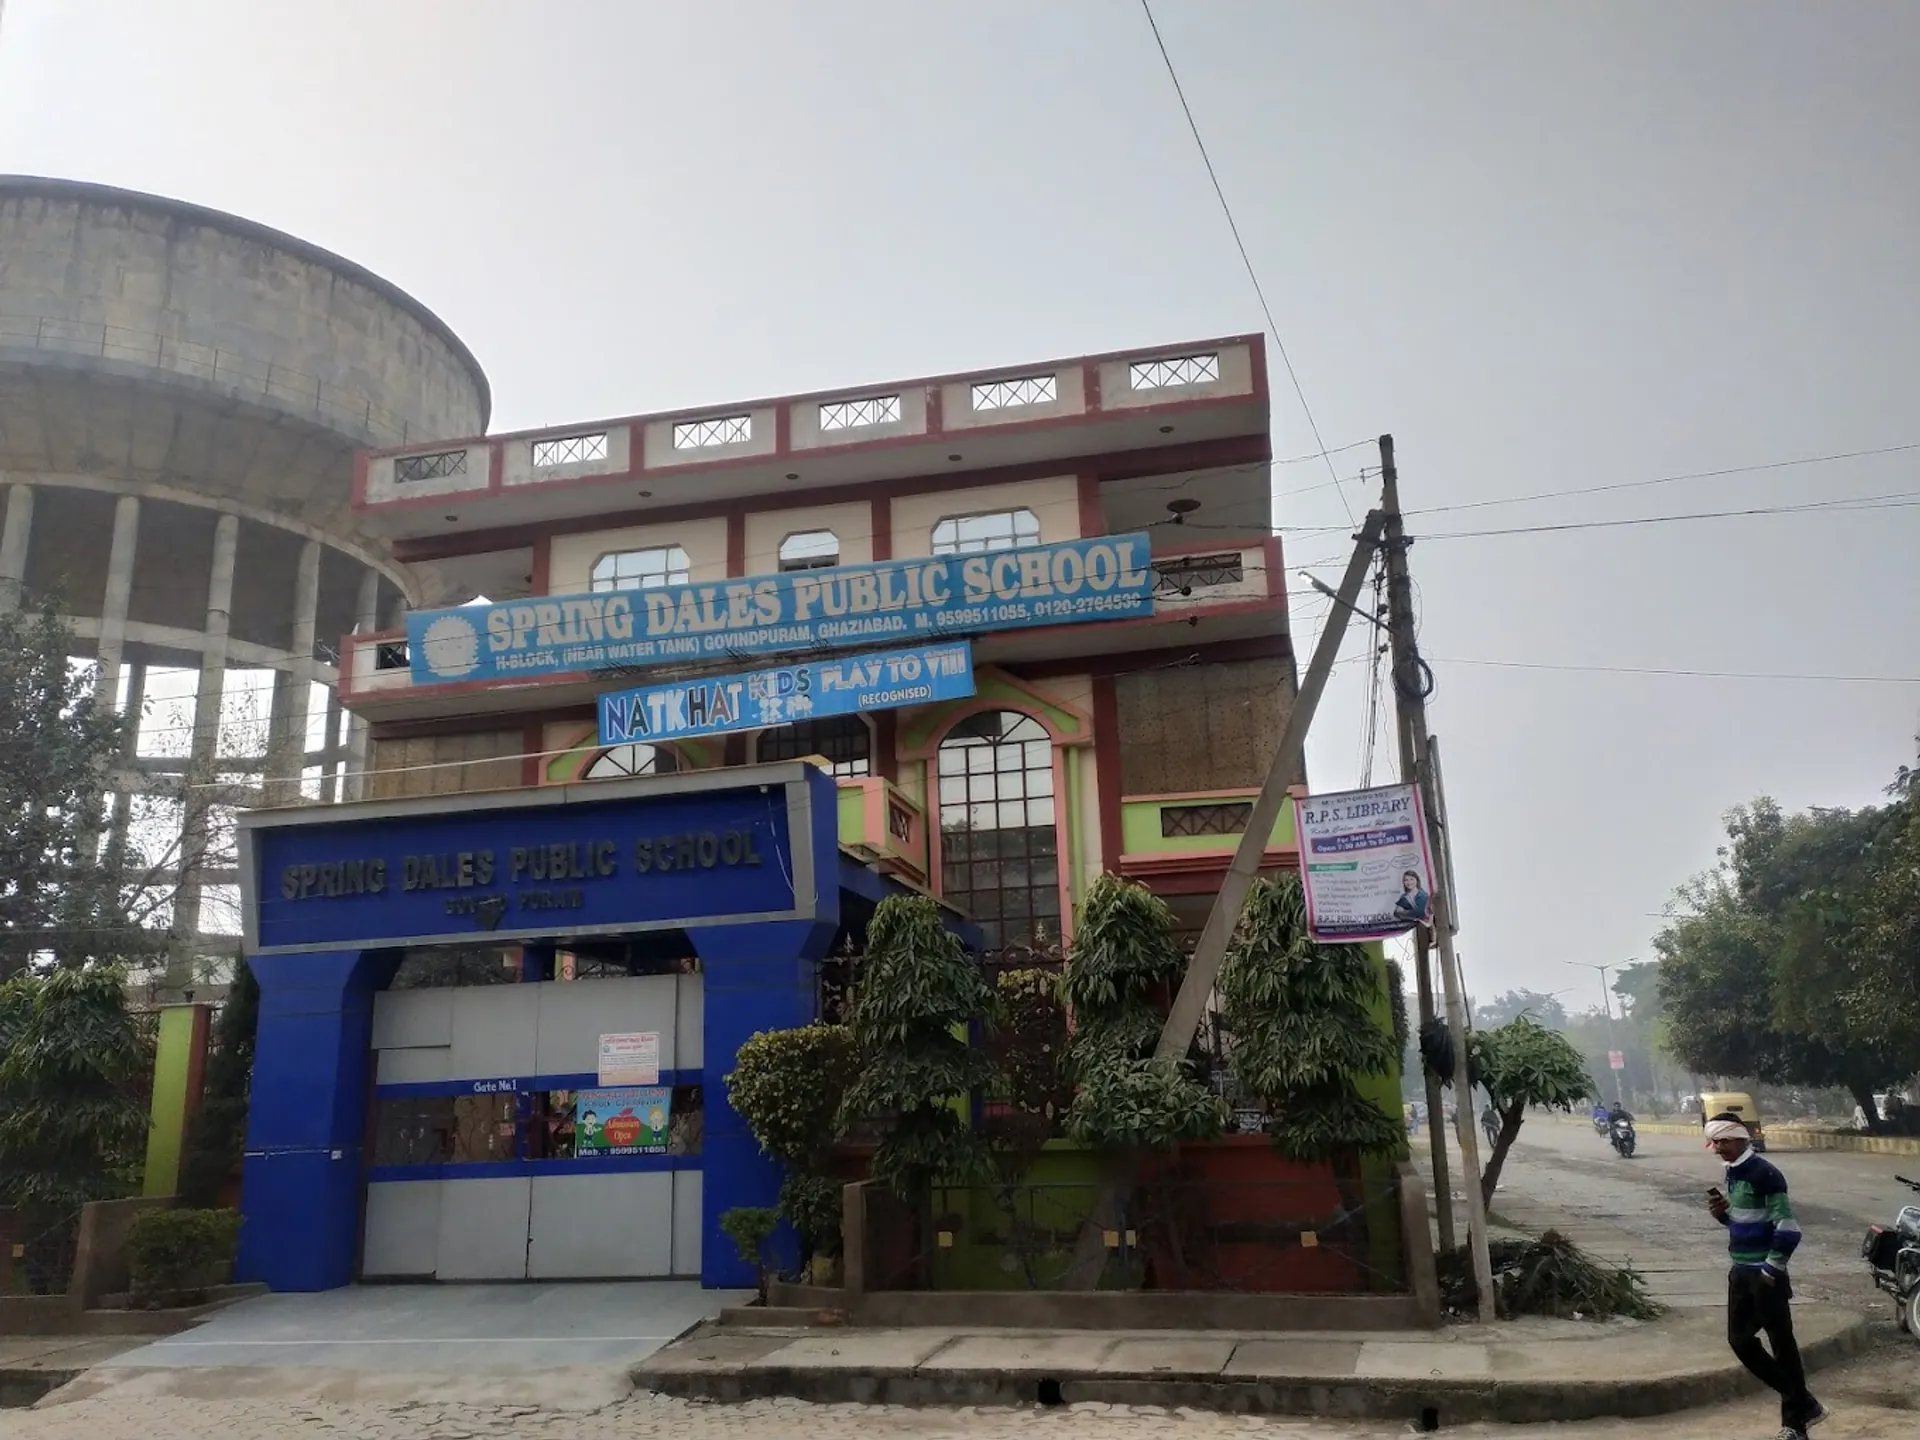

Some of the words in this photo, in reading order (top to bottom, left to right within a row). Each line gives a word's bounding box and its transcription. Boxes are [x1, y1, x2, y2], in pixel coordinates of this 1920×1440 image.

[487, 594, 635, 653] SPRING
[645, 580, 783, 634] DALES
[794, 561, 952, 622] PUBLIC
[963, 541, 1148, 605] SCHOOL
[563, 644, 605, 667] (NEAR
[608, 640, 655, 662] WATER
[657, 636, 700, 658] TANK)
[704, 624, 814, 650] GOVINDPURAM,
[818, 615, 908, 639] GHAZIABAD.
[915, 612, 933, 629] M.
[605, 680, 743, 741] NATKHAT
[748, 668, 812, 701] KIDS
[821, 659, 883, 693] PLAY
[887, 654, 921, 683] TO
[924, 648, 967, 679] VIII
[858, 684, 932, 708] (RECOGNISED)
[1305, 808, 1344, 825] R.P.S.
[1346, 796, 1411, 821] LIBRARY
[281, 856, 387, 900] SPRING
[401, 848, 495, 891] DALES
[510, 838, 618, 882] PUBLIC
[635, 829, 761, 873] SCHOOL
[1317, 844, 1337, 853] Open
[1355, 840, 1368, 849] AM
[1396, 834, 1409, 843] PM
[473, 1080, 497, 1093] Gate
